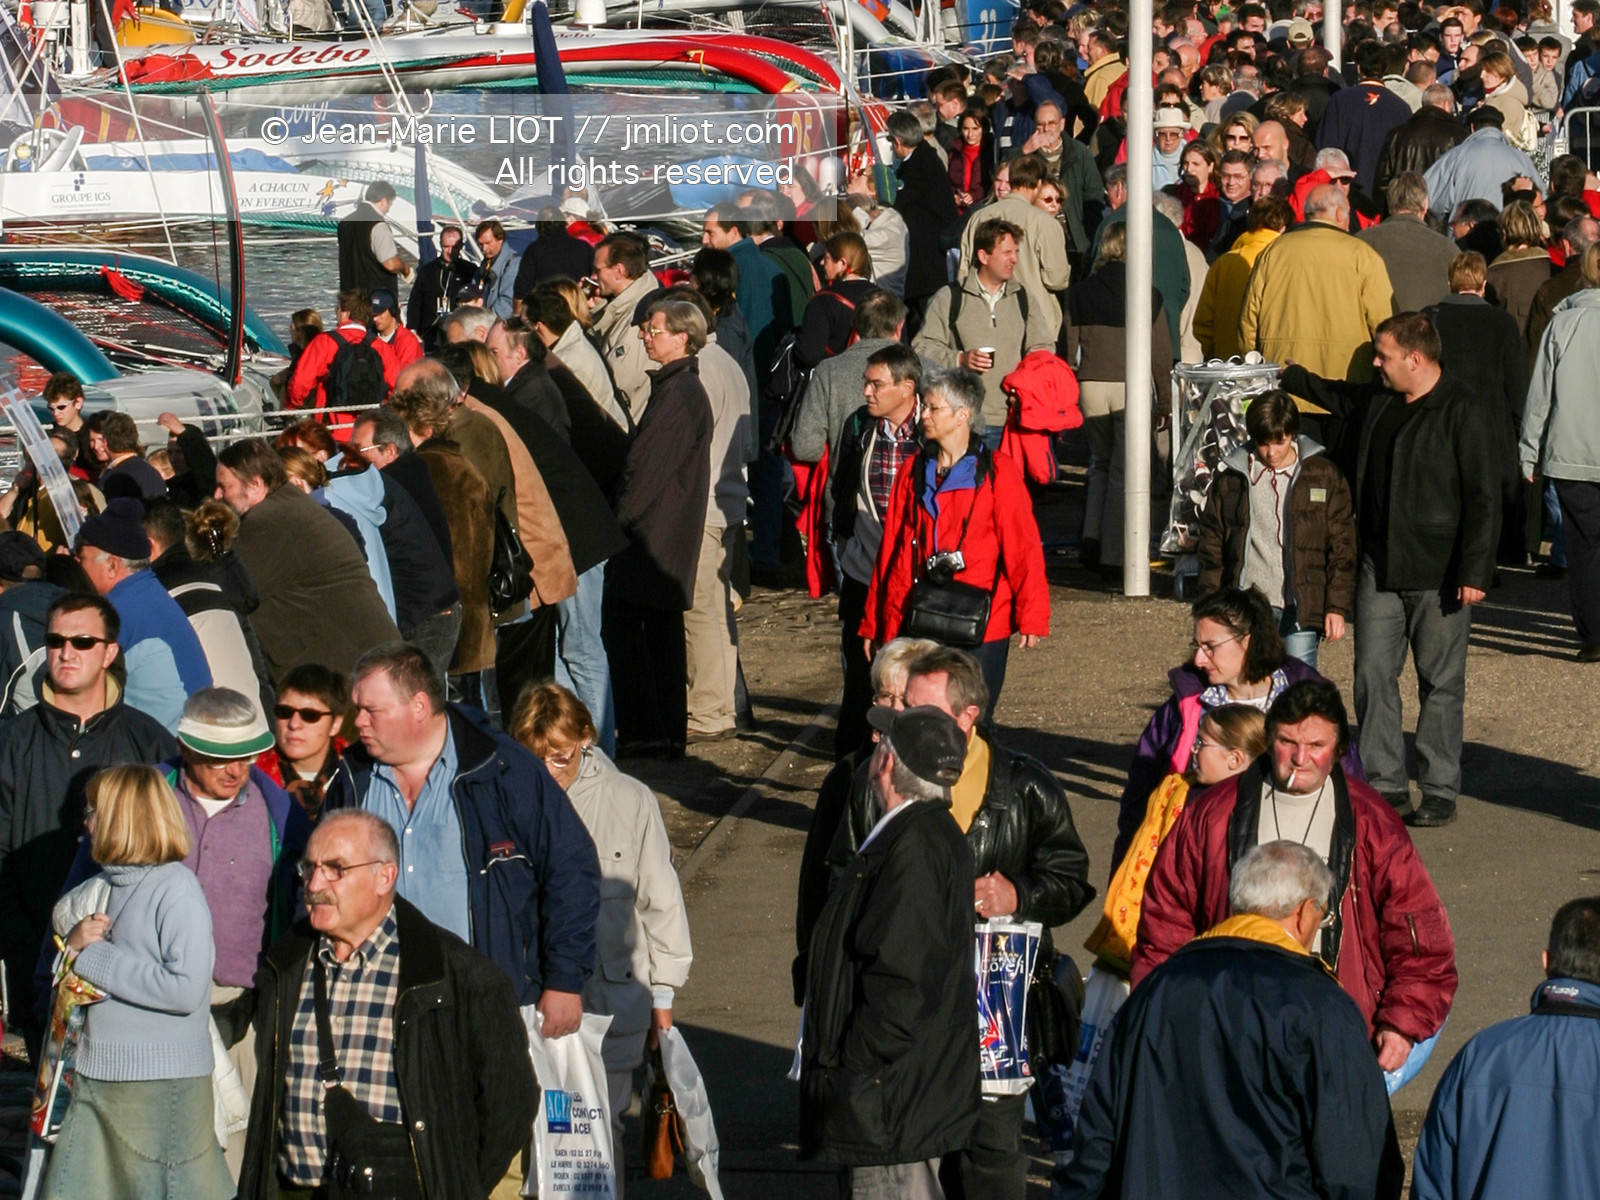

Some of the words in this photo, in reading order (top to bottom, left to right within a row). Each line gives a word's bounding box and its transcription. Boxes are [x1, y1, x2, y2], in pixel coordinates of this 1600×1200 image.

[209, 44, 371, 70] Sodebo
[248, 183, 257, 192] A
[259, 183, 310, 192] CHACUN
[51, 193, 93, 203] GROUPE
[94, 192, 111, 201] IGS
[256, 198, 306, 208] EVEREST
